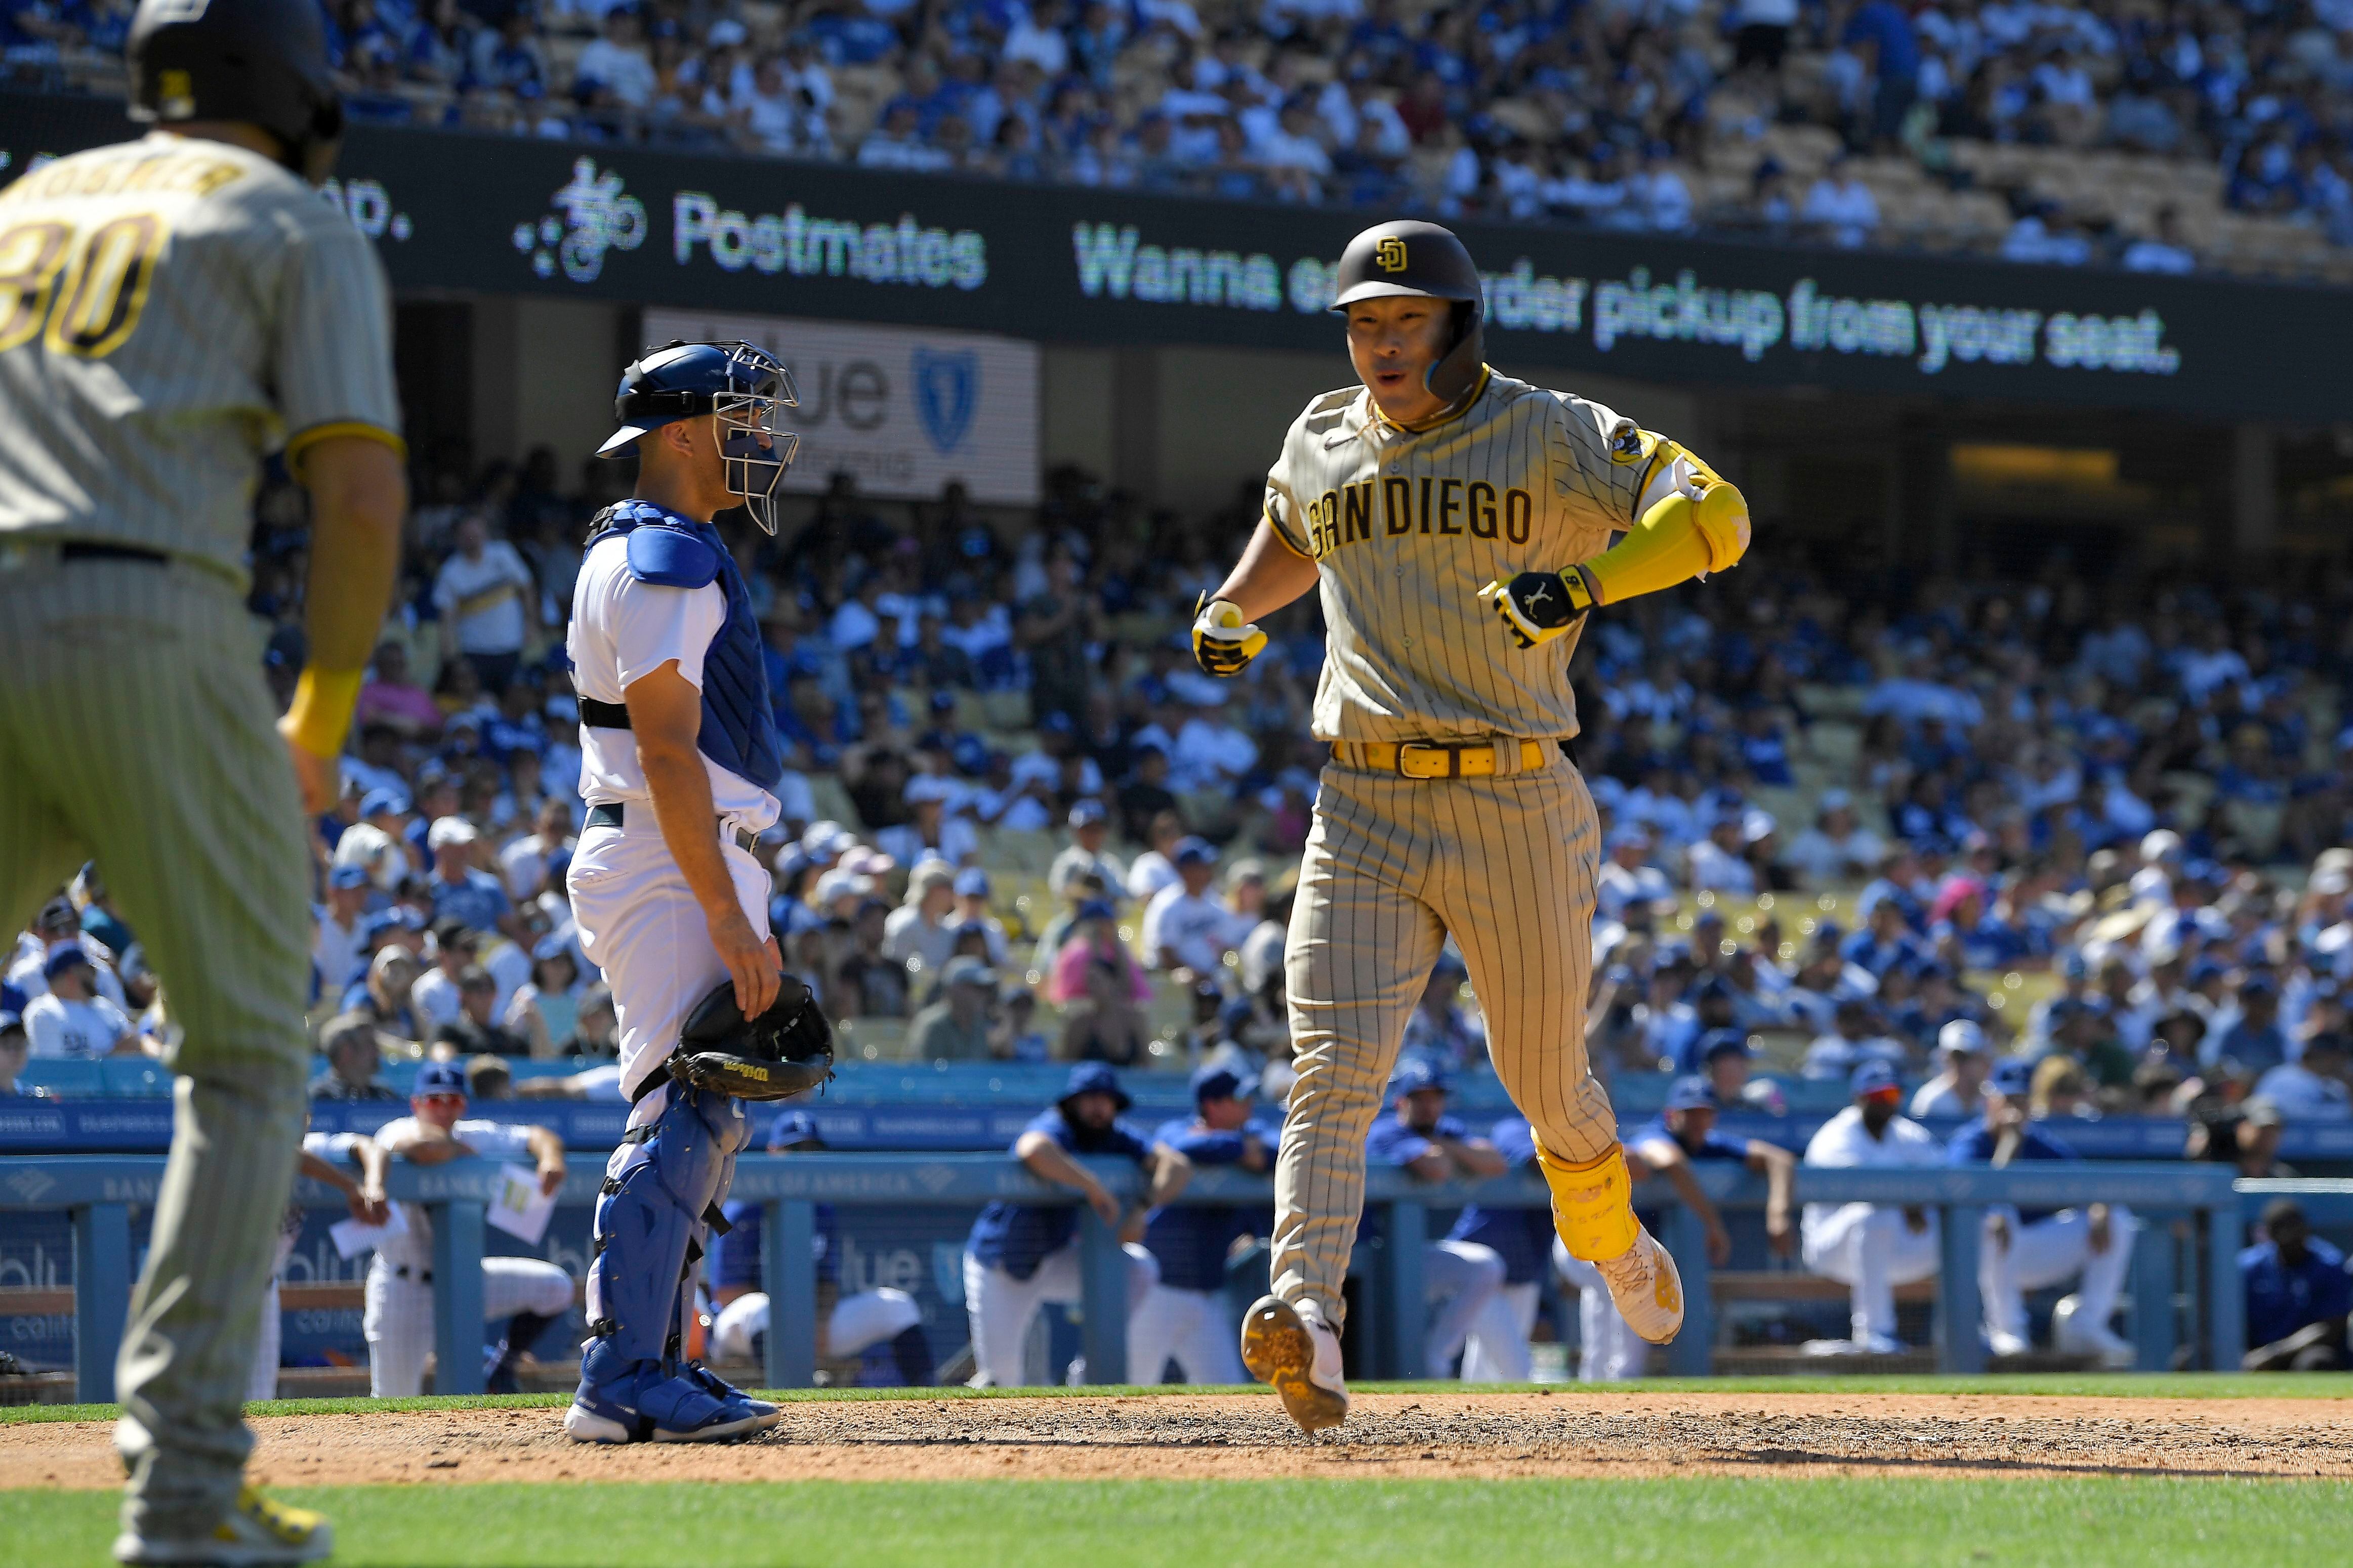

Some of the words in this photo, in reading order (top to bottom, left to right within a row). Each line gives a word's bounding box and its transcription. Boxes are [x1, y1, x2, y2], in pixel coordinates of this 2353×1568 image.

[673, 190, 987, 290] Postmates
[1376, 235, 1408, 273] SD
[1072, 220, 1282, 313] Wanna
[1480, 257, 1589, 332] rder
[1594, 264, 1785, 362] pickup
[1789, 277, 1917, 357] from
[1918, 303, 2043, 374] your
[2045, 309, 2181, 375] seat.
[1307, 480, 1375, 563] SAN
[1384, 477, 1533, 545] DIEGO
